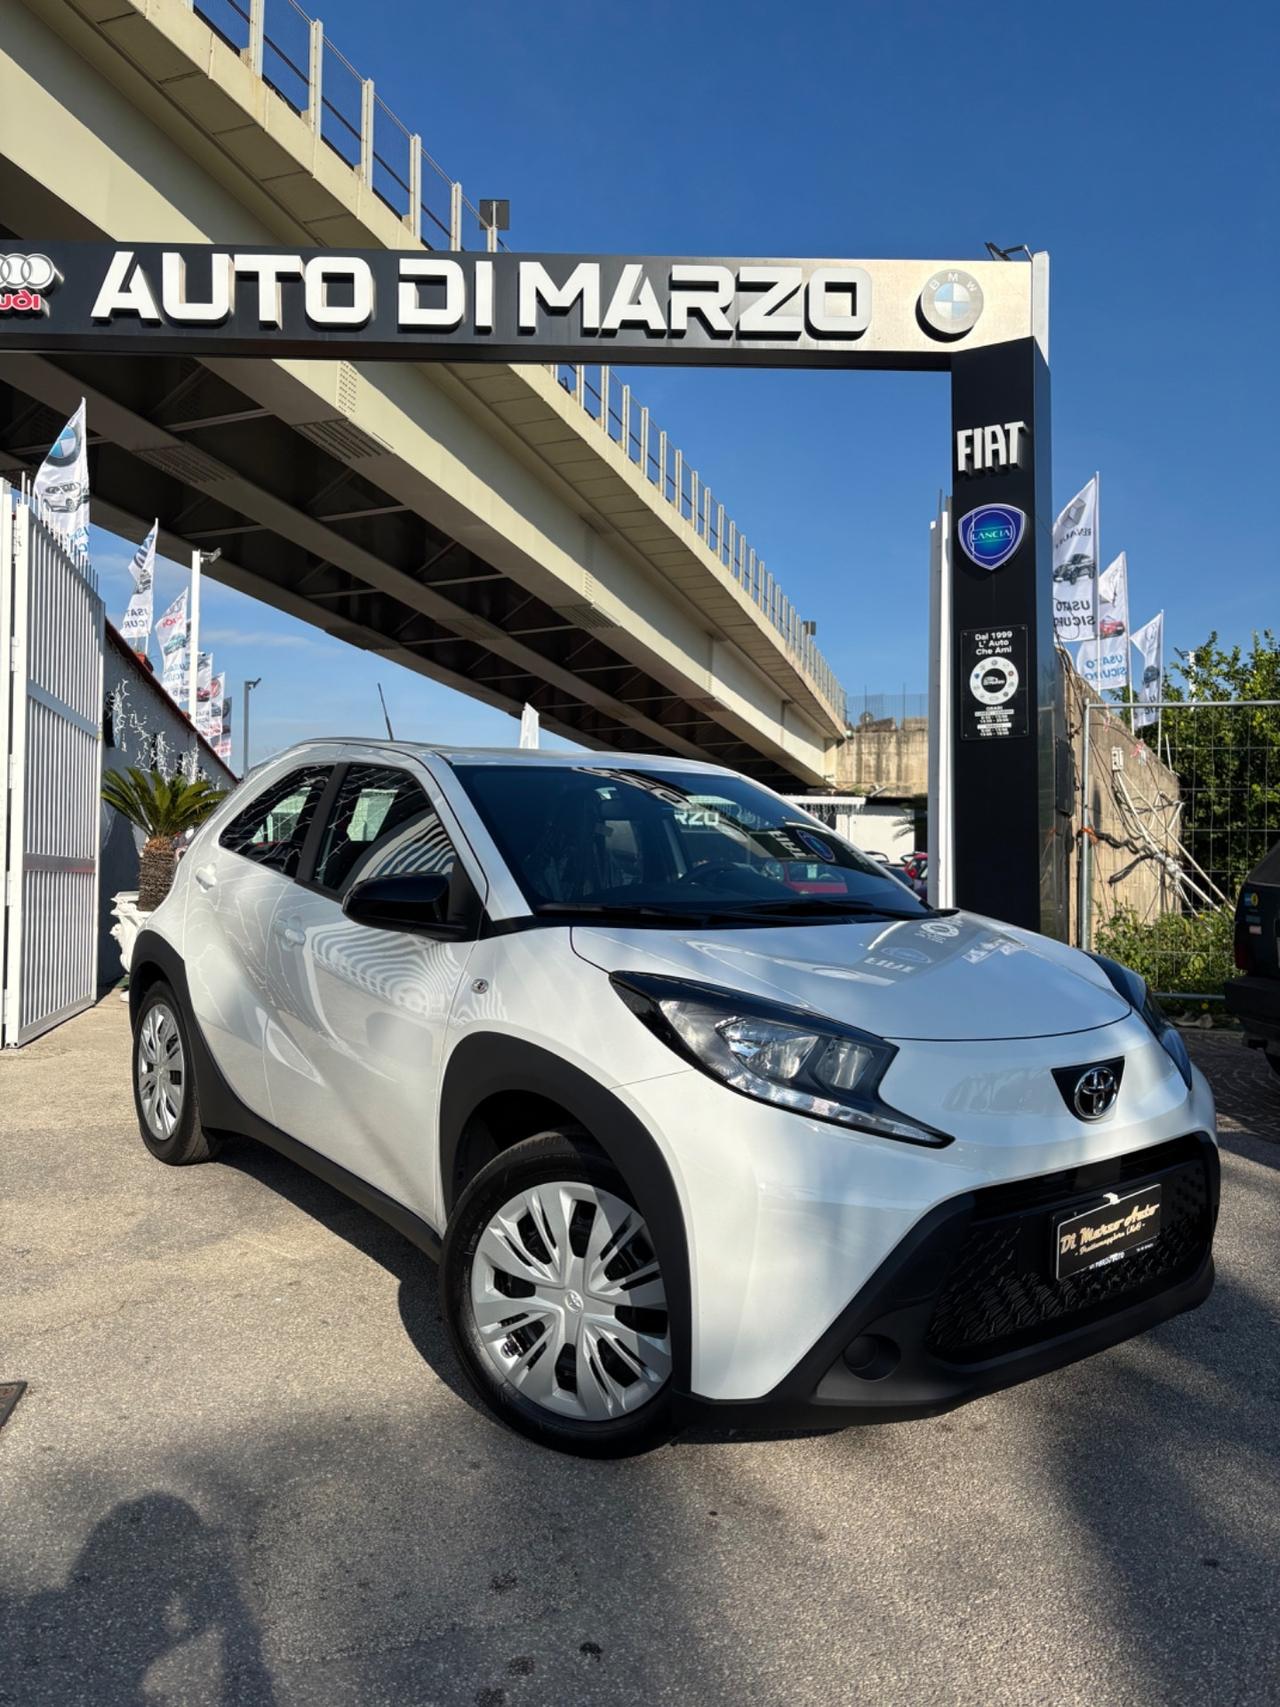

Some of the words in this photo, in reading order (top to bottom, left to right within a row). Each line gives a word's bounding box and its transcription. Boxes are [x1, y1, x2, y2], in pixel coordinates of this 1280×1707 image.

[90, 250, 373, 325] AUTO
[398, 257, 494, 328] DI
[518, 261, 872, 334] MARZO
[929, 272, 978, 292] BMW
[0, 289, 41, 310] udi
[957, 421, 1025, 472] FIAT
[972, 527, 1010, 542] LANCIA
[988, 639, 1010, 647] Auto
[991, 630, 1013, 640] 1999
